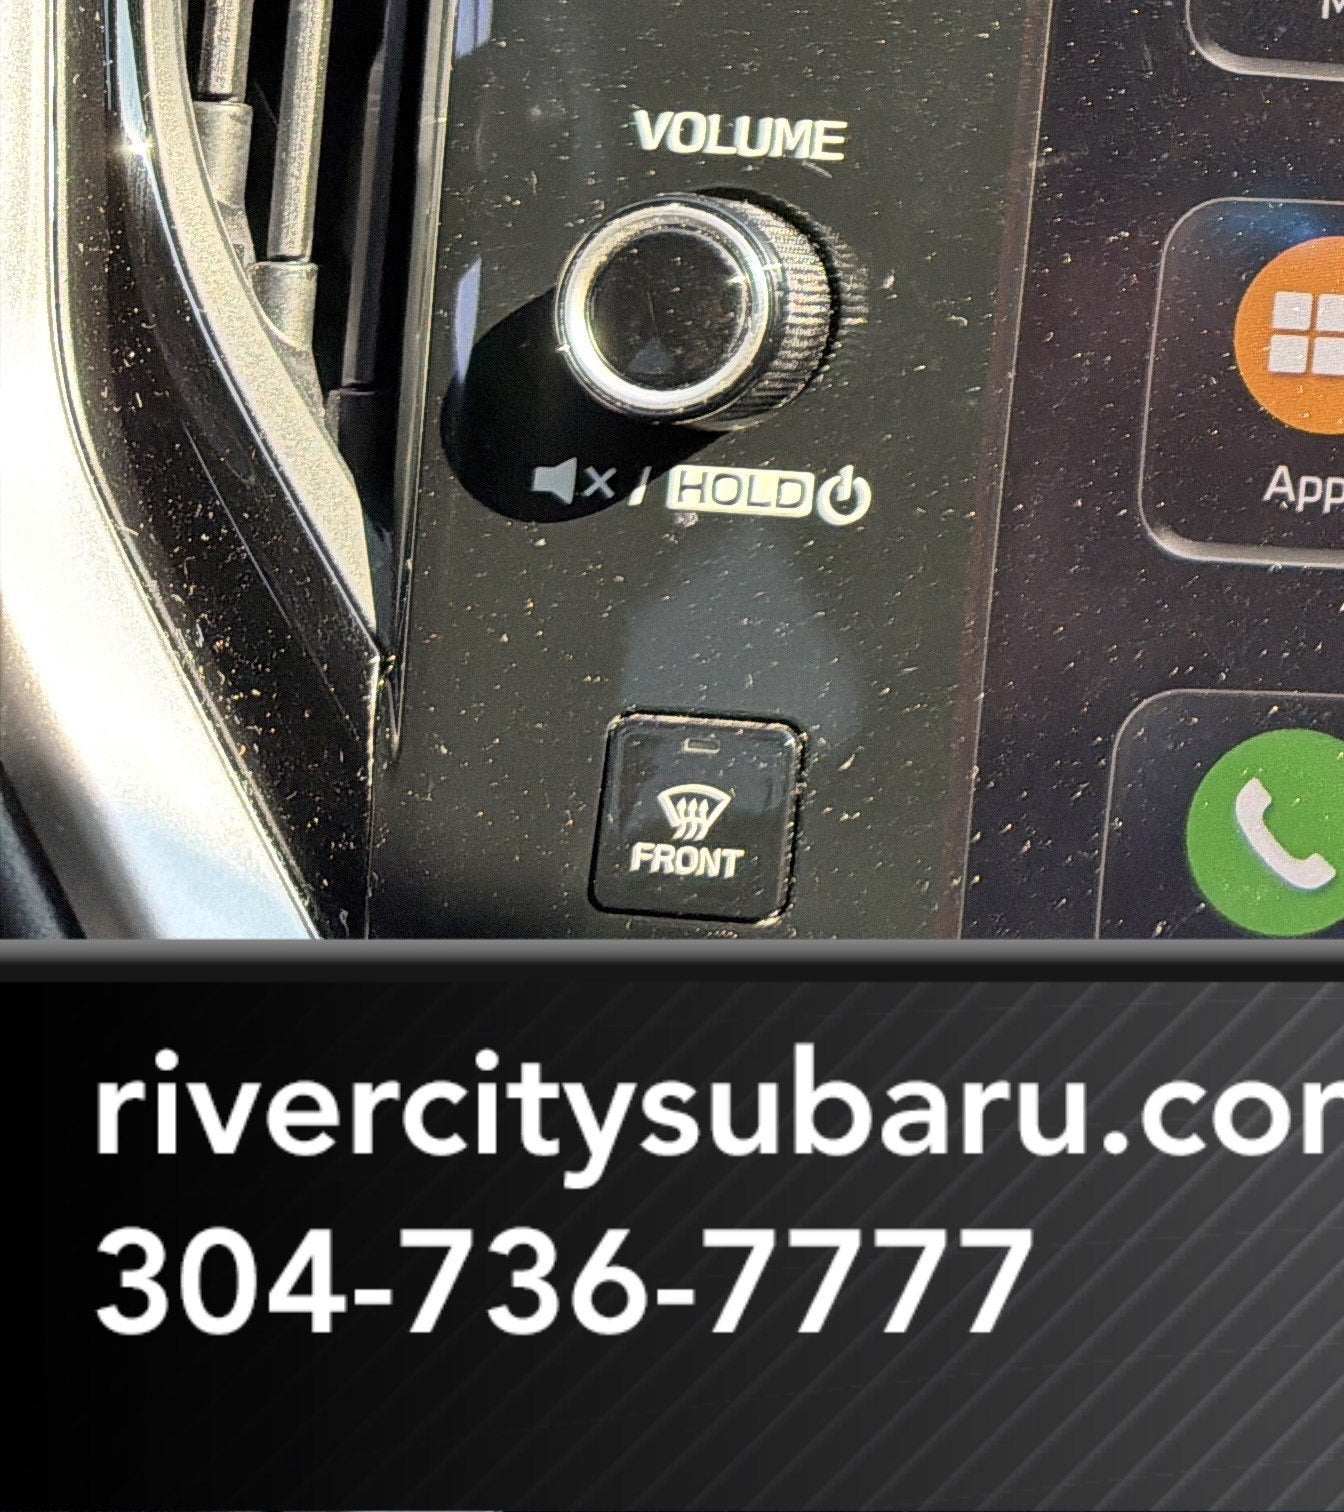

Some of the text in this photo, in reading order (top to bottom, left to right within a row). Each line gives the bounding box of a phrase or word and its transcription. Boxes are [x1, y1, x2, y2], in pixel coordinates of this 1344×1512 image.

[633, 109, 849, 162] VOLUME
[673, 468, 812, 513] HOLD
[629, 842, 745, 879] FRONT
